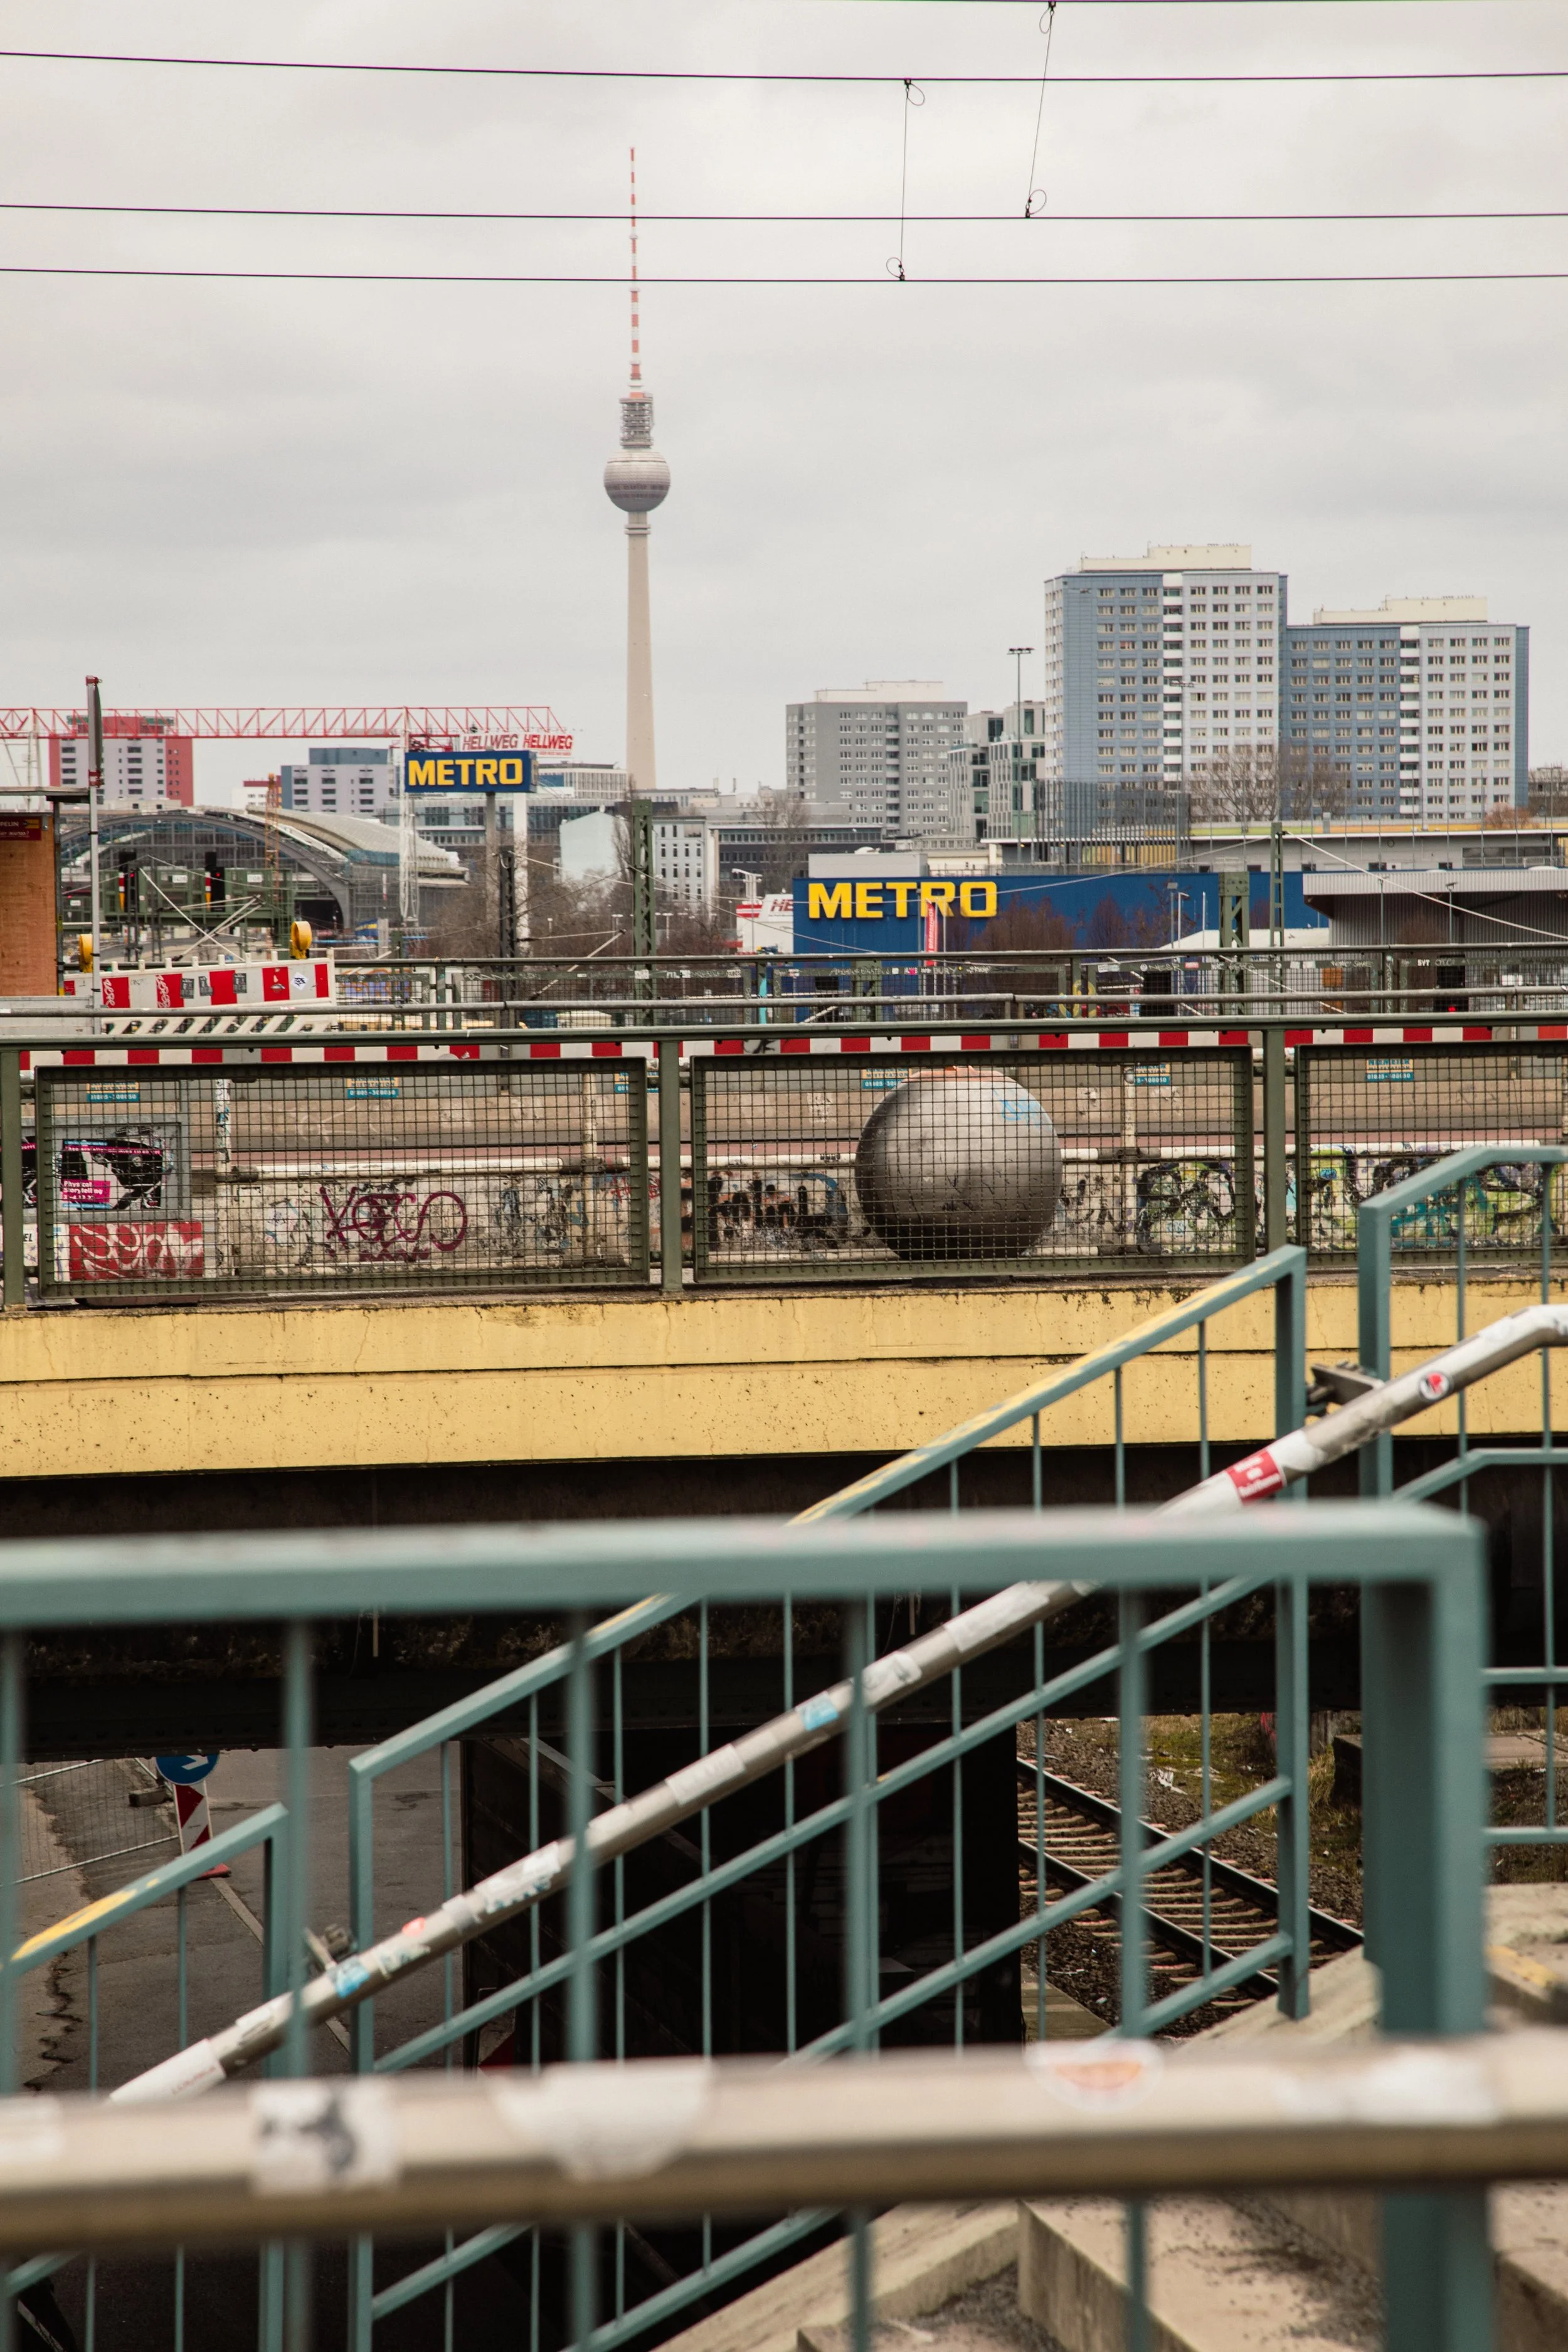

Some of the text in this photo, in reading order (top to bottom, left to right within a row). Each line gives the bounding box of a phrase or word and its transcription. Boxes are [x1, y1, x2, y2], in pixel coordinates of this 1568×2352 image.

[462, 734, 518, 750] HELLWEG
[522, 734, 573, 750] HELLWEG
[408, 759, 522, 785] METRO
[808, 881, 997, 918] METRO
